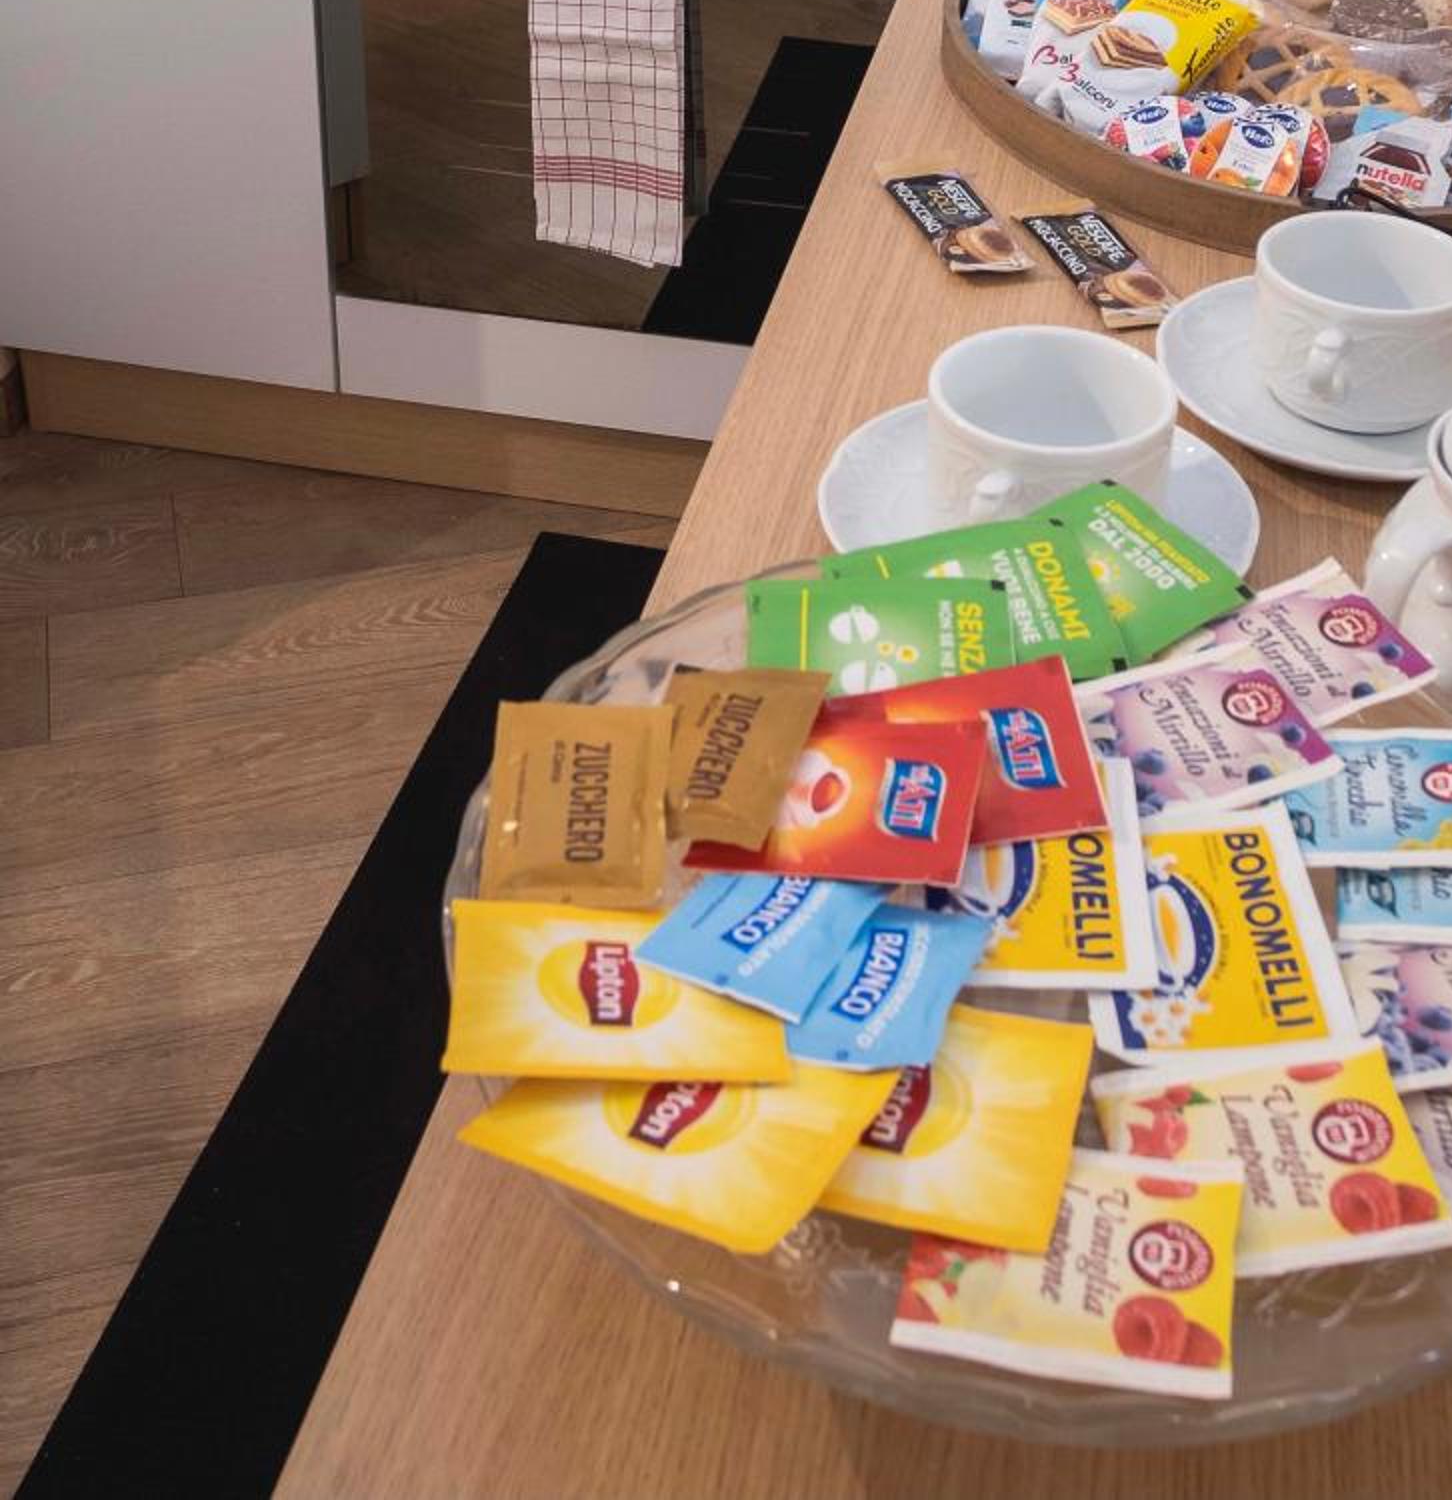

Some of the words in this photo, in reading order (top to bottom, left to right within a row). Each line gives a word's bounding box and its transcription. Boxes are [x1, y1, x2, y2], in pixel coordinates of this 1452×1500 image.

[927, 188, 959, 217] GOLD
[1356, 162, 1426, 192] nutella
[1028, 218, 1087, 276] MOCACCINO
[1066, 224, 1104, 258] GOLD
[1026, 540, 1091, 641] DONAMI
[1118, 545, 1177, 593] 2000
[1237, 616, 1318, 699] Mirtillo
[687, 691, 766, 801] ZUCCHERO
[1001, 724, 1046, 780] ATI
[1138, 688, 1211, 778] Mirtillo
[1164, 675, 1240, 761] Tentazioni
[564, 741, 613, 864] ZUCCHERO
[888, 775, 936, 829] ATI
[730, 875, 814, 945] BIANCO
[1066, 832, 1120, 962] OMELLI
[1222, 831, 1315, 1029] BONOMELLI
[589, 944, 627, 1021] Lipton
[839, 931, 905, 1016] BIANCO
[1219, 1092, 1277, 1210] Lampone
[1263, 1083, 1326, 1209] Vaniglia
[1075, 1186, 1130, 1318] Vaniglia
